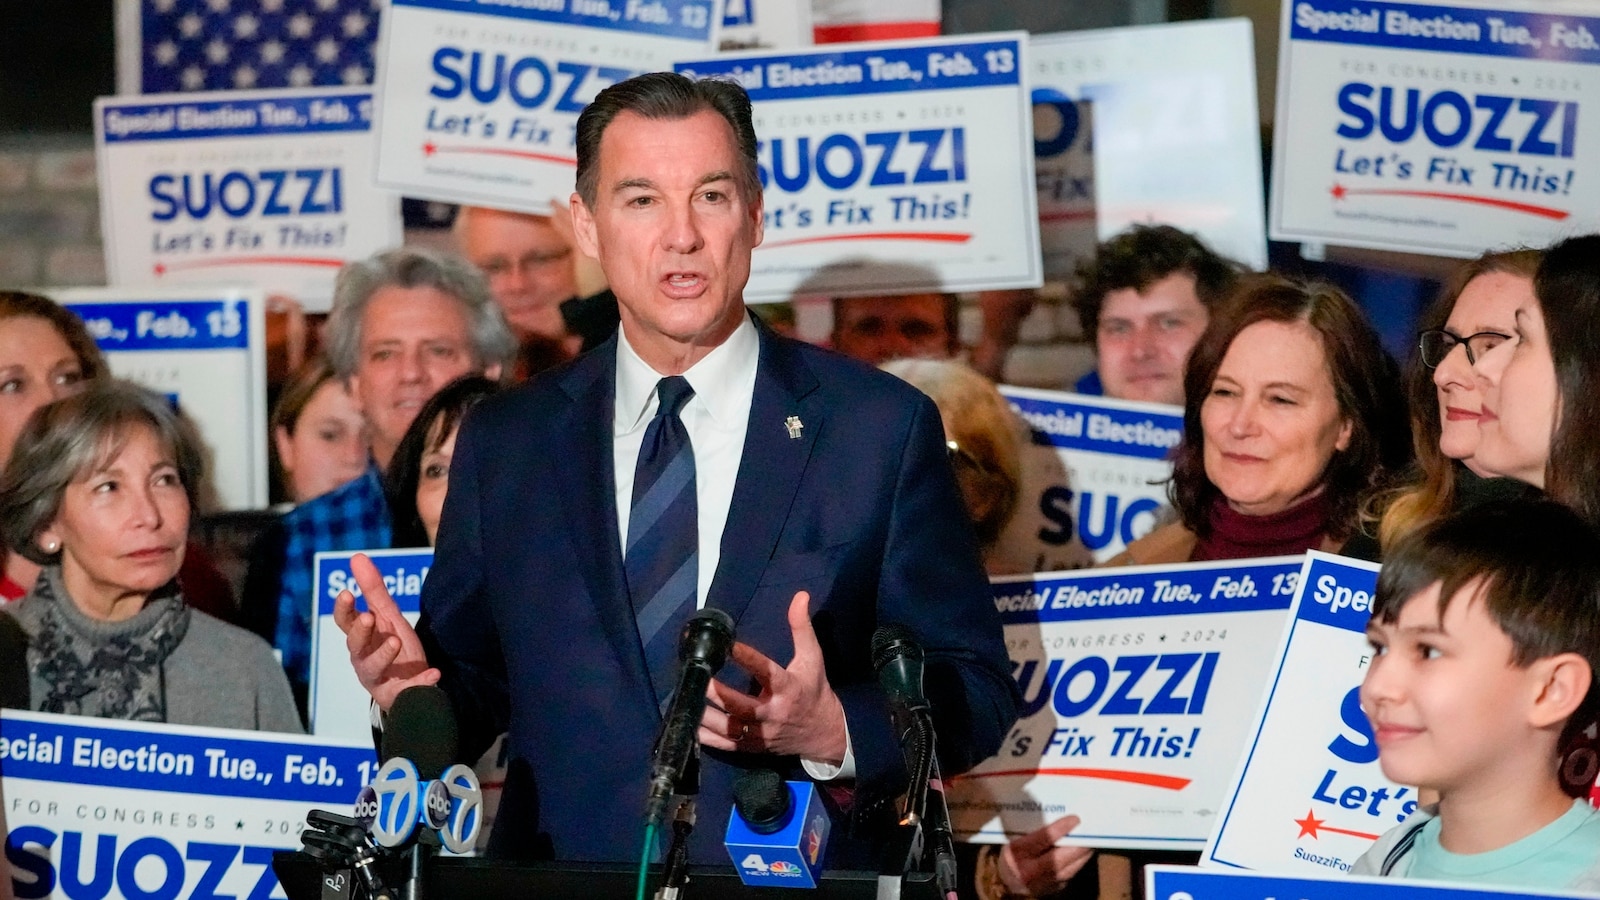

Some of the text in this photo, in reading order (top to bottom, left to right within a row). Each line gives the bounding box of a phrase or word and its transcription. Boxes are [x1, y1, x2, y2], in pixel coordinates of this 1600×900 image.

[680, 5, 708, 29] 13
[1296, 4, 1379, 33] Special
[1385, 10, 1481, 41] Election
[1487, 19, 1541, 49] Tue.,
[430, 47, 636, 113] SUOZ
[766, 62, 863, 88] Election
[867, 57, 922, 81] Tue.,
[928, 51, 978, 77] Feb.
[985, 49, 1014, 74] 13
[106, 108, 174, 136] Special
[178, 106, 255, 130] Election
[426, 107, 496, 139] Let's
[508, 118, 551, 146] Fix
[1336, 83, 1578, 159] SUOZZI
[1335, 149, 1574, 195] Let's Fix This!
[148, 168, 342, 221] SUOZZI
[827, 200, 873, 225] Fix
[891, 194, 971, 221] This!
[136, 311, 197, 338] Feb.
[206, 308, 241, 338] 13
[1087, 413, 1181, 447] Election
[1038, 486, 1161, 550] SUO
[1051, 584, 1145, 610] Election
[1151, 580, 1202, 604] Tue.,
[1210, 575, 1258, 599] Feb.
[1271, 572, 1299, 596] 13
[1181, 629, 1228, 643] 2024
[1001, 652, 1220, 718] UOZZI
[72, 737, 194, 775] Election
[205, 749, 274, 786] Tue.,
[283, 755, 344, 787] Feb.
[1041, 728, 1096, 756] Fix
[1110, 727, 1201, 759] This!
[13, 798, 305, 836] FOR CONGRESS 202
[354, 797, 378, 819] abc
[427, 791, 451, 816] abc
[5, 825, 298, 900] SUOZZ
[741, 854, 769, 871] 4
